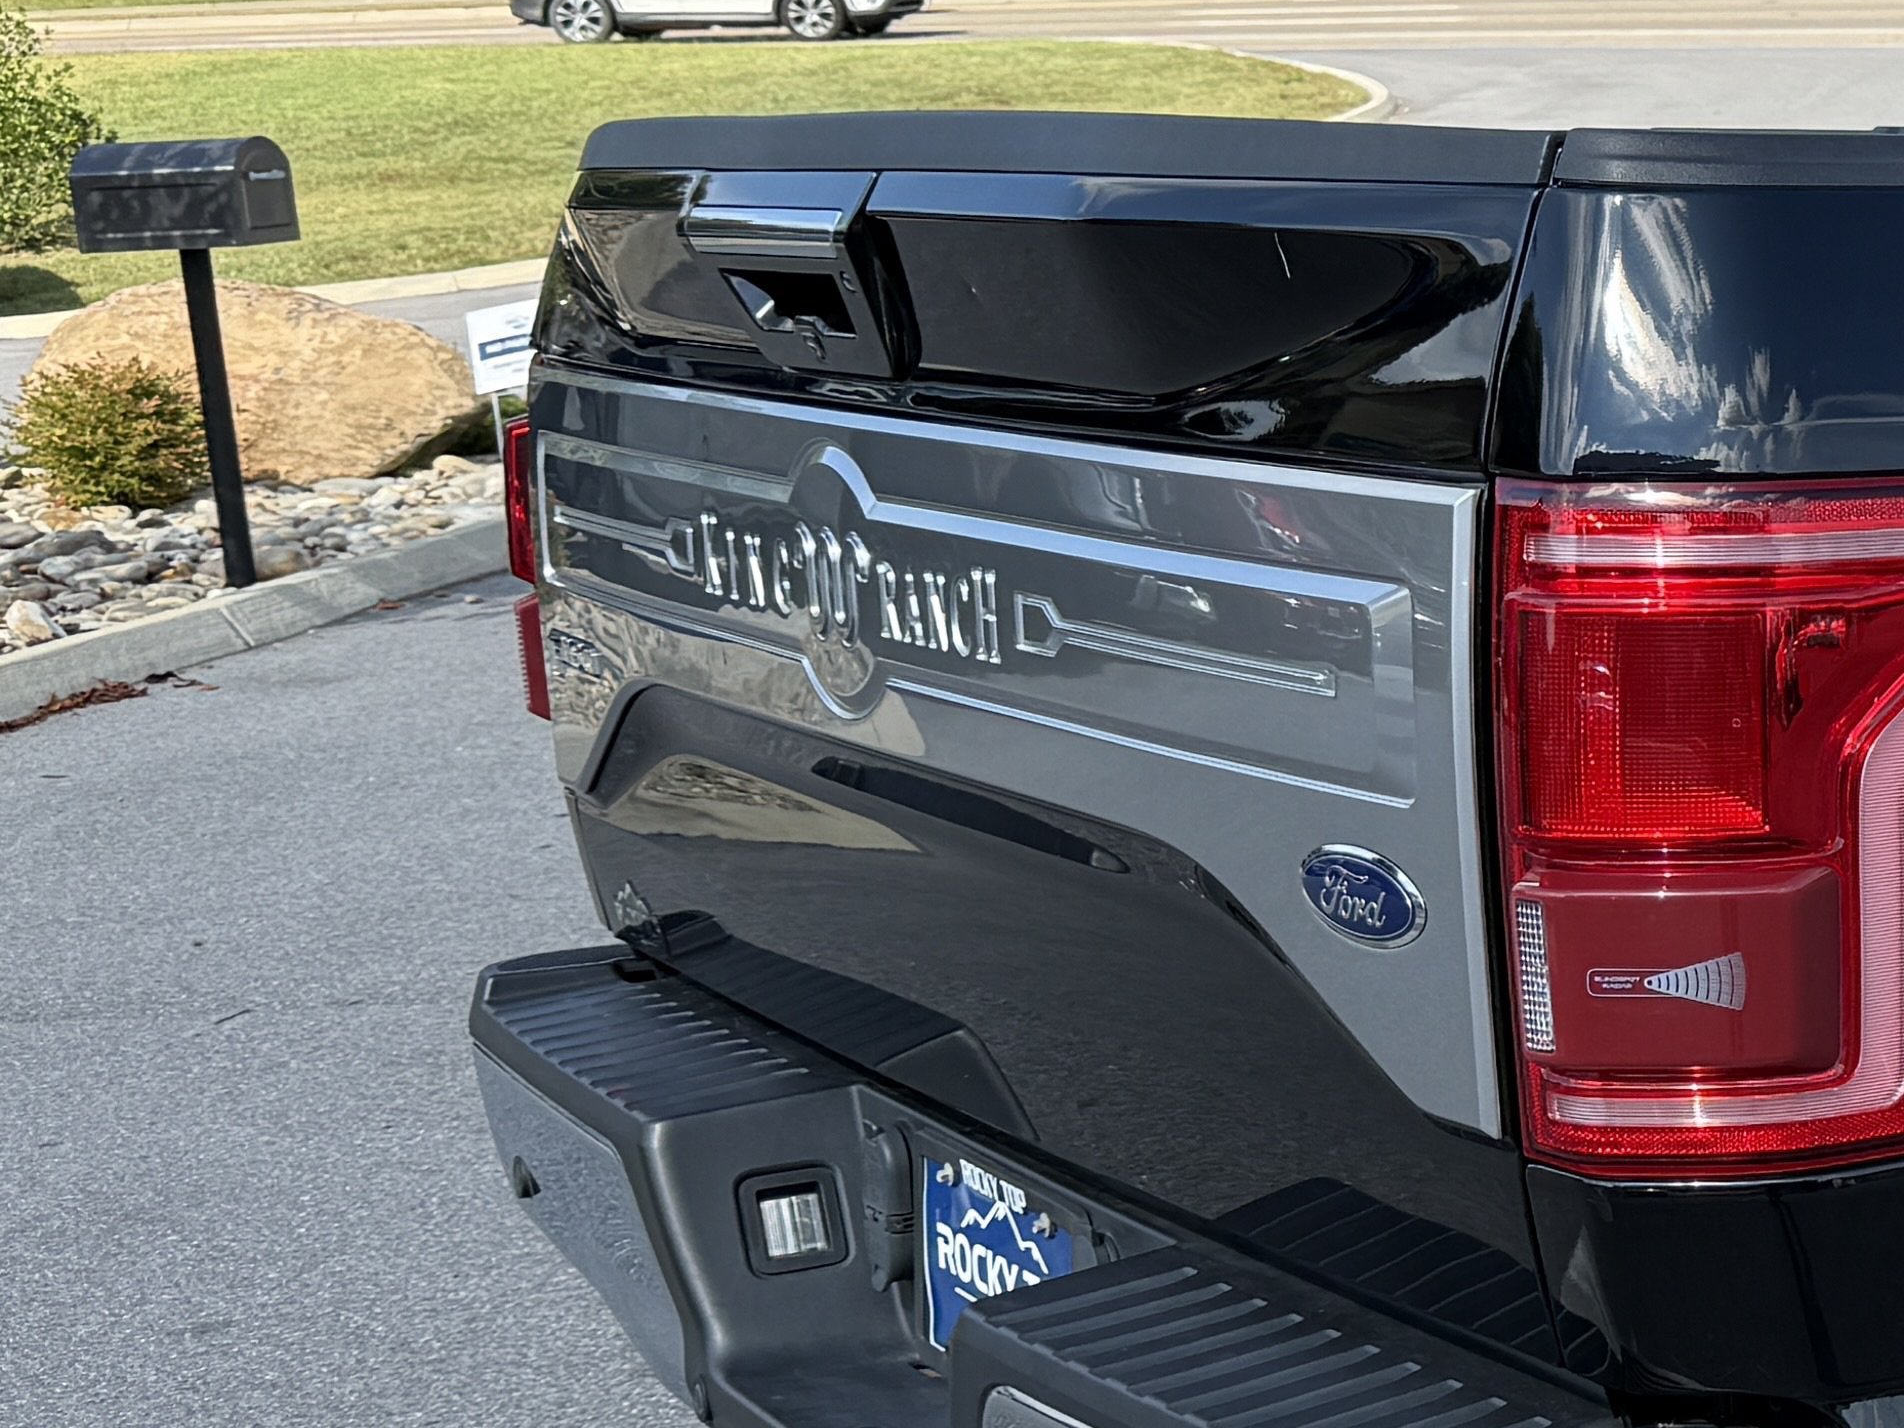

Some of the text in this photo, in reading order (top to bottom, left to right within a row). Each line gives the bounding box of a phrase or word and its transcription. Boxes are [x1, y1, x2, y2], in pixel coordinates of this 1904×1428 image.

[700, 510, 1002, 665] KING RANCH
[1320, 864, 1387, 928] Ford
[959, 1158, 1027, 1215] ROCKY TOP
